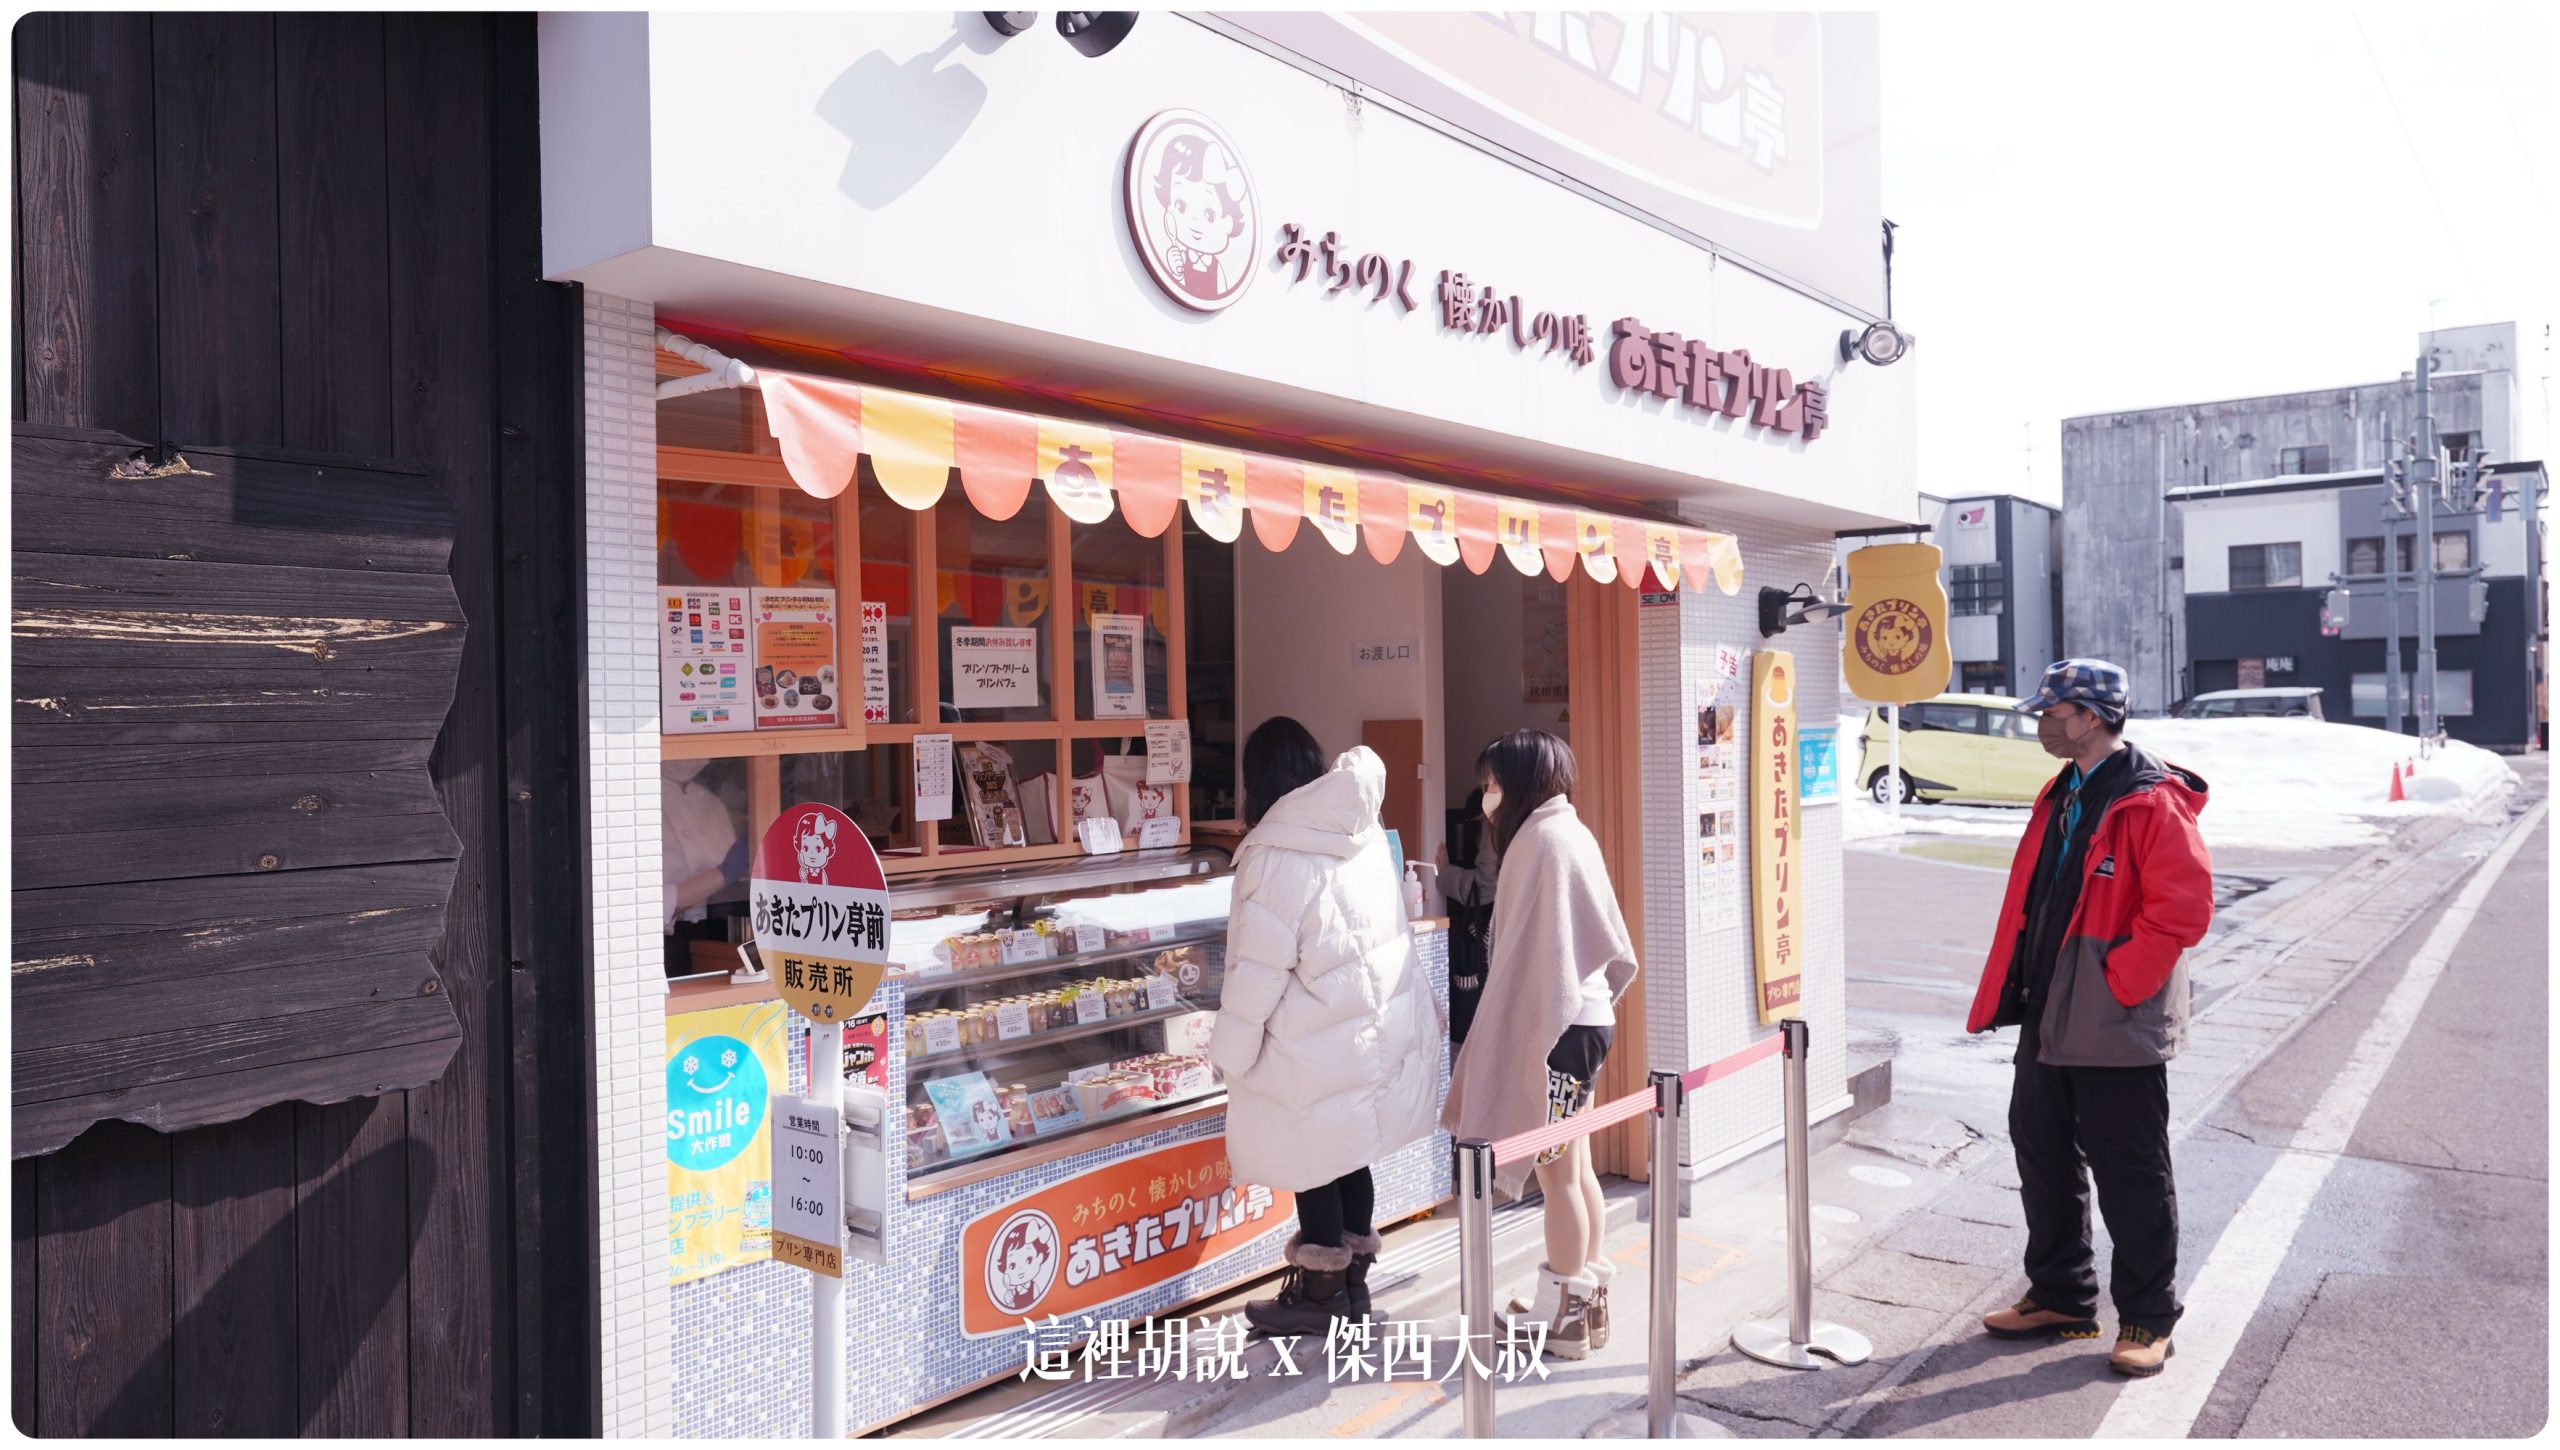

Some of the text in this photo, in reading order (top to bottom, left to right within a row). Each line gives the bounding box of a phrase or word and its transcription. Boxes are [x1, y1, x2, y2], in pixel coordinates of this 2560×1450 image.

[1277, 223, 1828, 440] みちのく 懐かしの味 あきたプリン亭
[962, 664, 1029, 674] プリンソフトクリーム
[1360, 645, 1410, 661] お渡し口
[976, 678, 1017, 688] プリンパフェ
[1772, 715, 1792, 965] あきたプリン亭
[756, 893, 885, 951] あきたプリン亭前
[784, 958, 854, 998] 販売所
[667, 1097, 750, 1140] Smile
[788, 1115, 821, 1133] 営業時間
[691, 1132, 732, 1156] 大作戦
[790, 1144, 824, 1165] 10:00
[790, 1195, 824, 1217] 16:00
[1072, 1157, 1233, 1227] みちのく 懐かしの味
[1065, 1183, 1274, 1288] あきたプリン亭
[776, 1238, 837, 1271] プリン専門店
